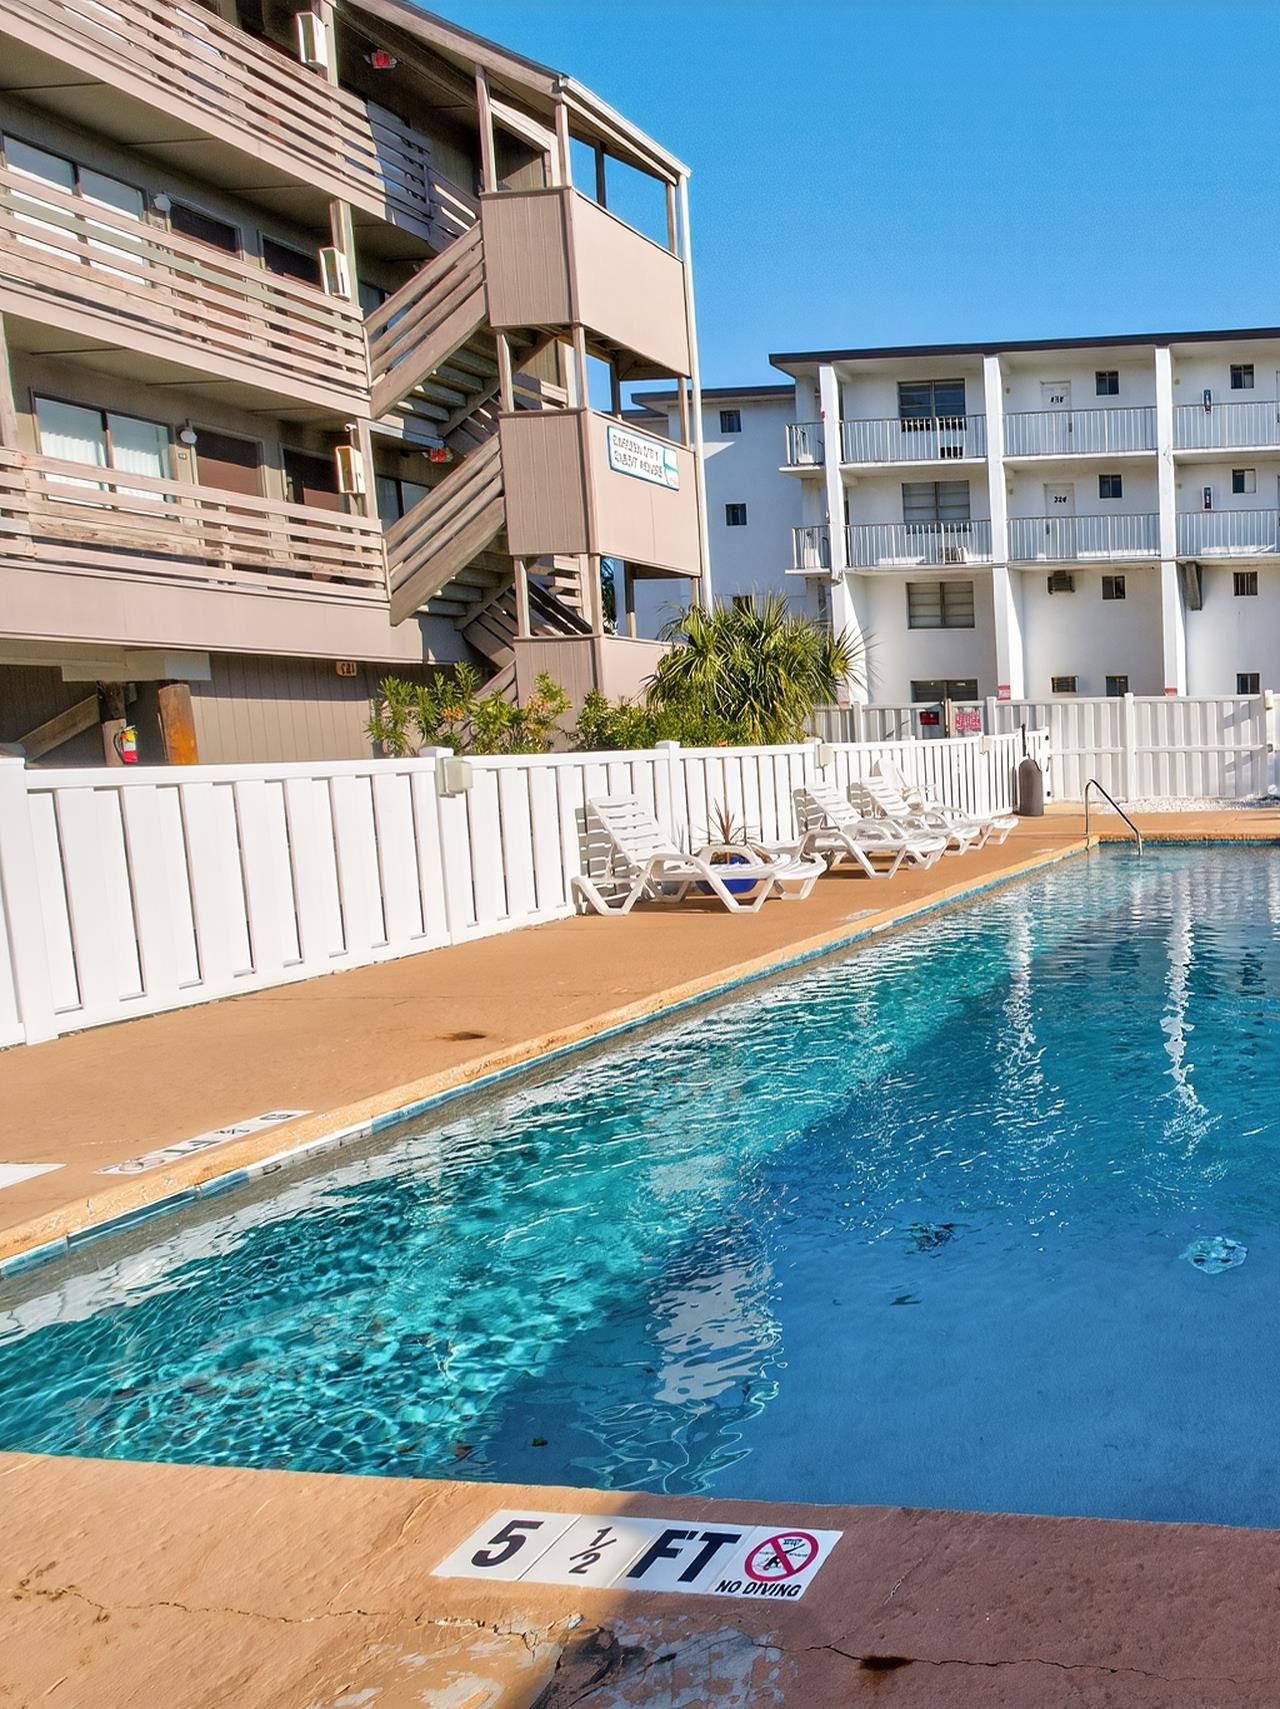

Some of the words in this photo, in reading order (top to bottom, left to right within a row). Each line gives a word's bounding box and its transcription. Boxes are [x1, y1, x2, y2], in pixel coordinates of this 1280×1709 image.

[471, 1520, 544, 1567] 5
[626, 1529, 743, 1582] FT
[715, 1580, 741, 1594] NO
[742, 1581, 802, 1598] DIVING
